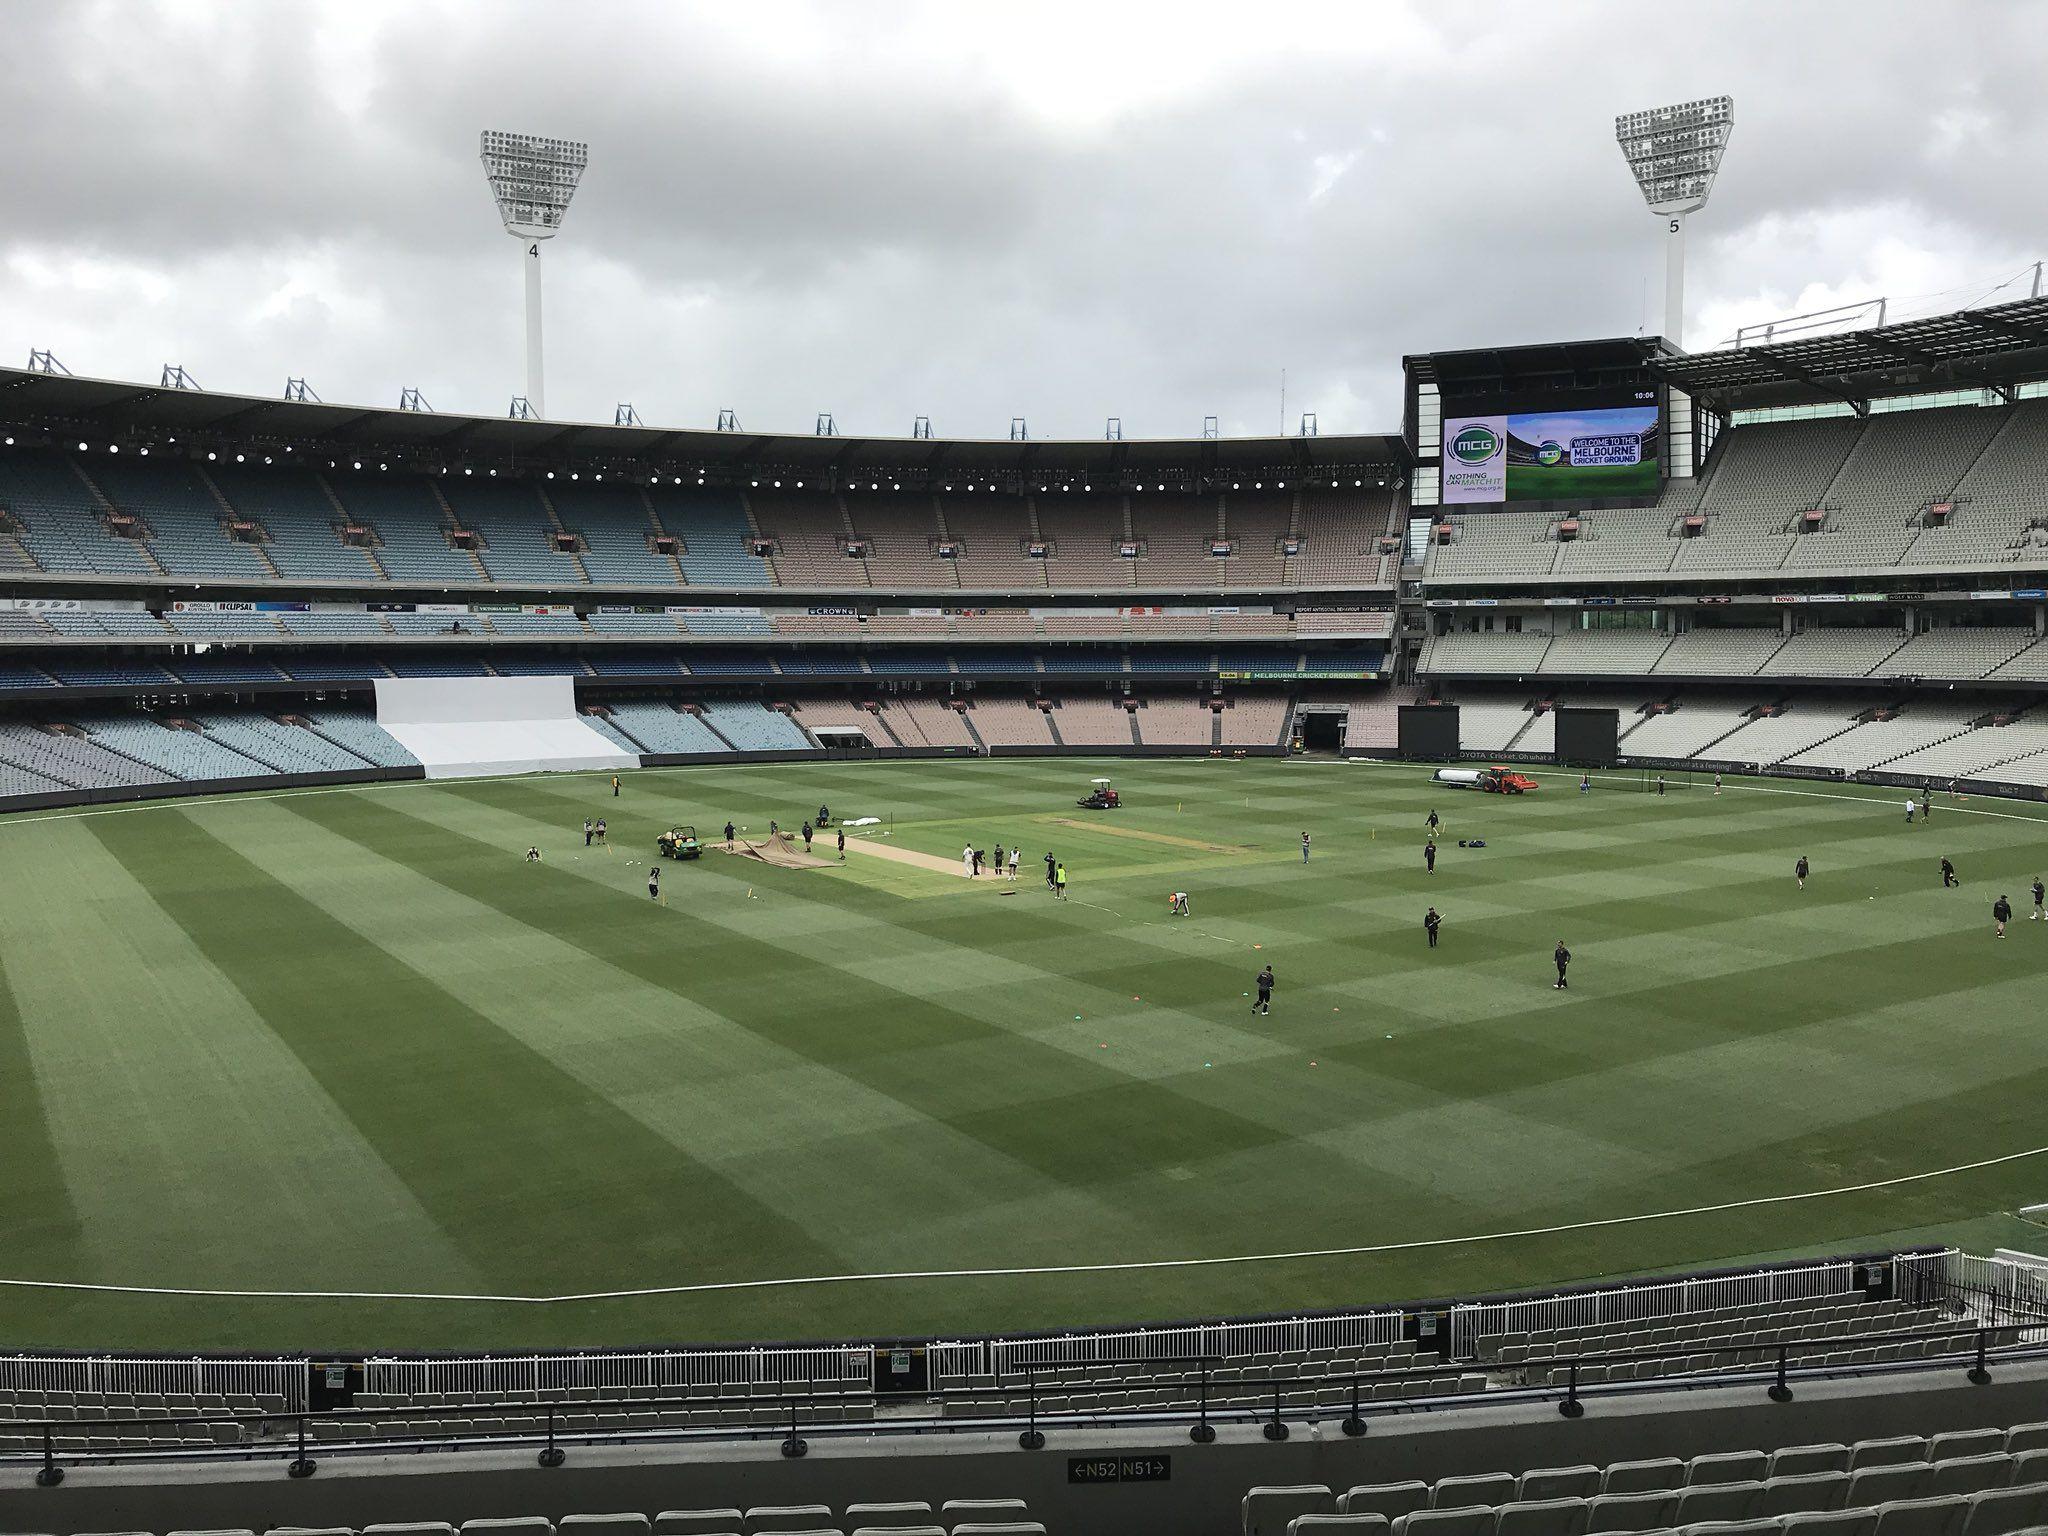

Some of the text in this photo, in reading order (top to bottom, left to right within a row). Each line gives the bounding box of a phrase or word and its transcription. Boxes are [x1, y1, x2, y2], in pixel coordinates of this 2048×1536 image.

[1670, 219, 1680, 233] 5
[529, 244, 539, 258] 4
[1634, 391, 1655, 401] 10:06
[1458, 439, 1492, 452] MCG
[1573, 436, 1637, 449] WELCOME TO THE
[1539, 450, 1558, 459] MCG
[1574, 445, 1636, 458] MELBOURNE
[1573, 455, 1636, 466] CRICKET GROUND
[1448, 472, 1488, 480] NOTHING
[1446, 479, 1461, 487] CAN
[1461, 478, 1492, 486] MATCH
[225, 603, 253, 611] CLIPSAL
[1459, 751, 1487, 759] OYOTA
[1891, 774, 1917, 786] STAND
[1086, 1462, 1117, 1477] N52
[1123, 1461, 1152, 1476] N51
